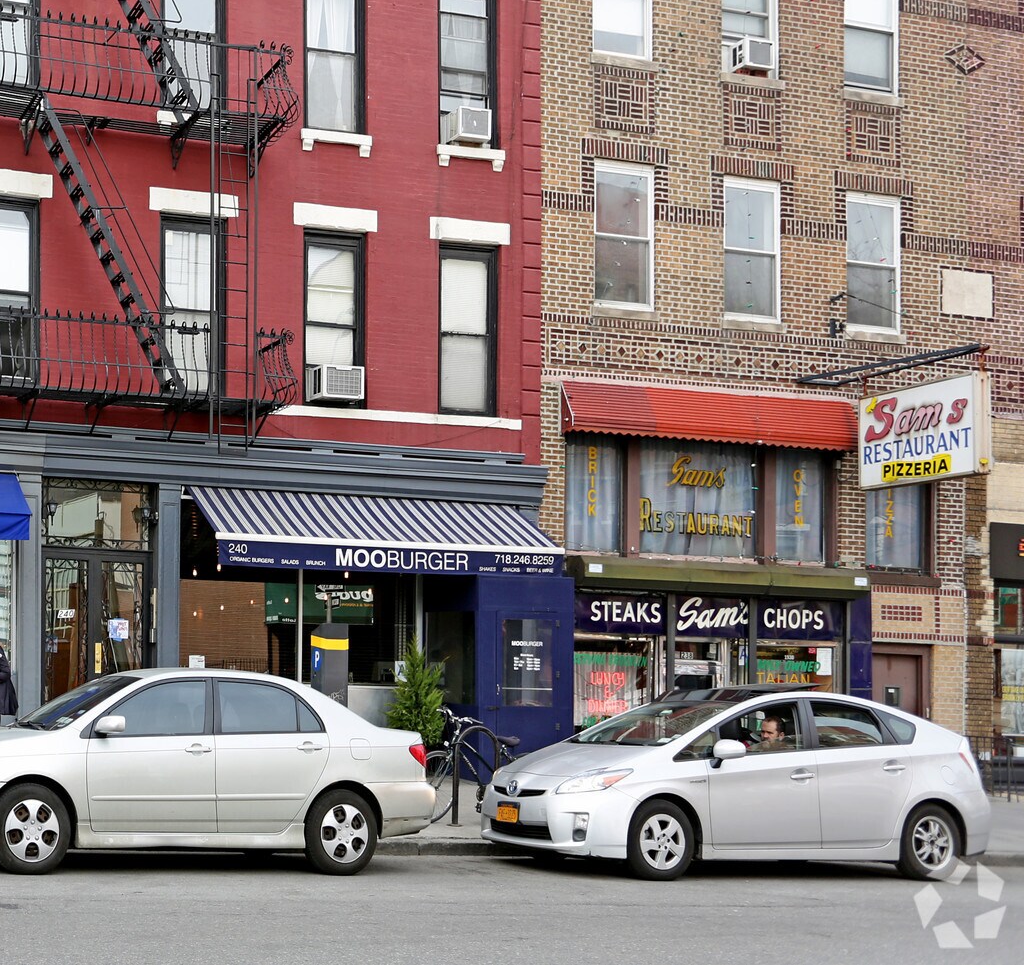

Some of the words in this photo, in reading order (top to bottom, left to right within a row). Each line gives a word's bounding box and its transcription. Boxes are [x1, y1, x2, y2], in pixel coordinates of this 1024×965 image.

[863, 426, 972, 466] RESTAURANT
[666, 455, 727, 488] Sam's
[883, 458, 949, 479] PIZZERIA
[587, 446, 598, 517] BRICK
[793, 469, 804, 528] OVEN
[640, 497, 754, 538] RESTAURANT
[884, 488, 894, 538] IZZA
[228, 543, 248, 555] 240
[335, 547, 469, 571] MOOBURGER
[494, 554, 555, 566] 718.246.8259
[58, 610, 75, 618] 240
[590, 600, 662, 624] STEAKS
[676, 596, 749, 631] Sam's
[763, 607, 825, 630] CHOPS
[314, 650, 320, 668] P
[755, 671, 811, 684] TALIAN
